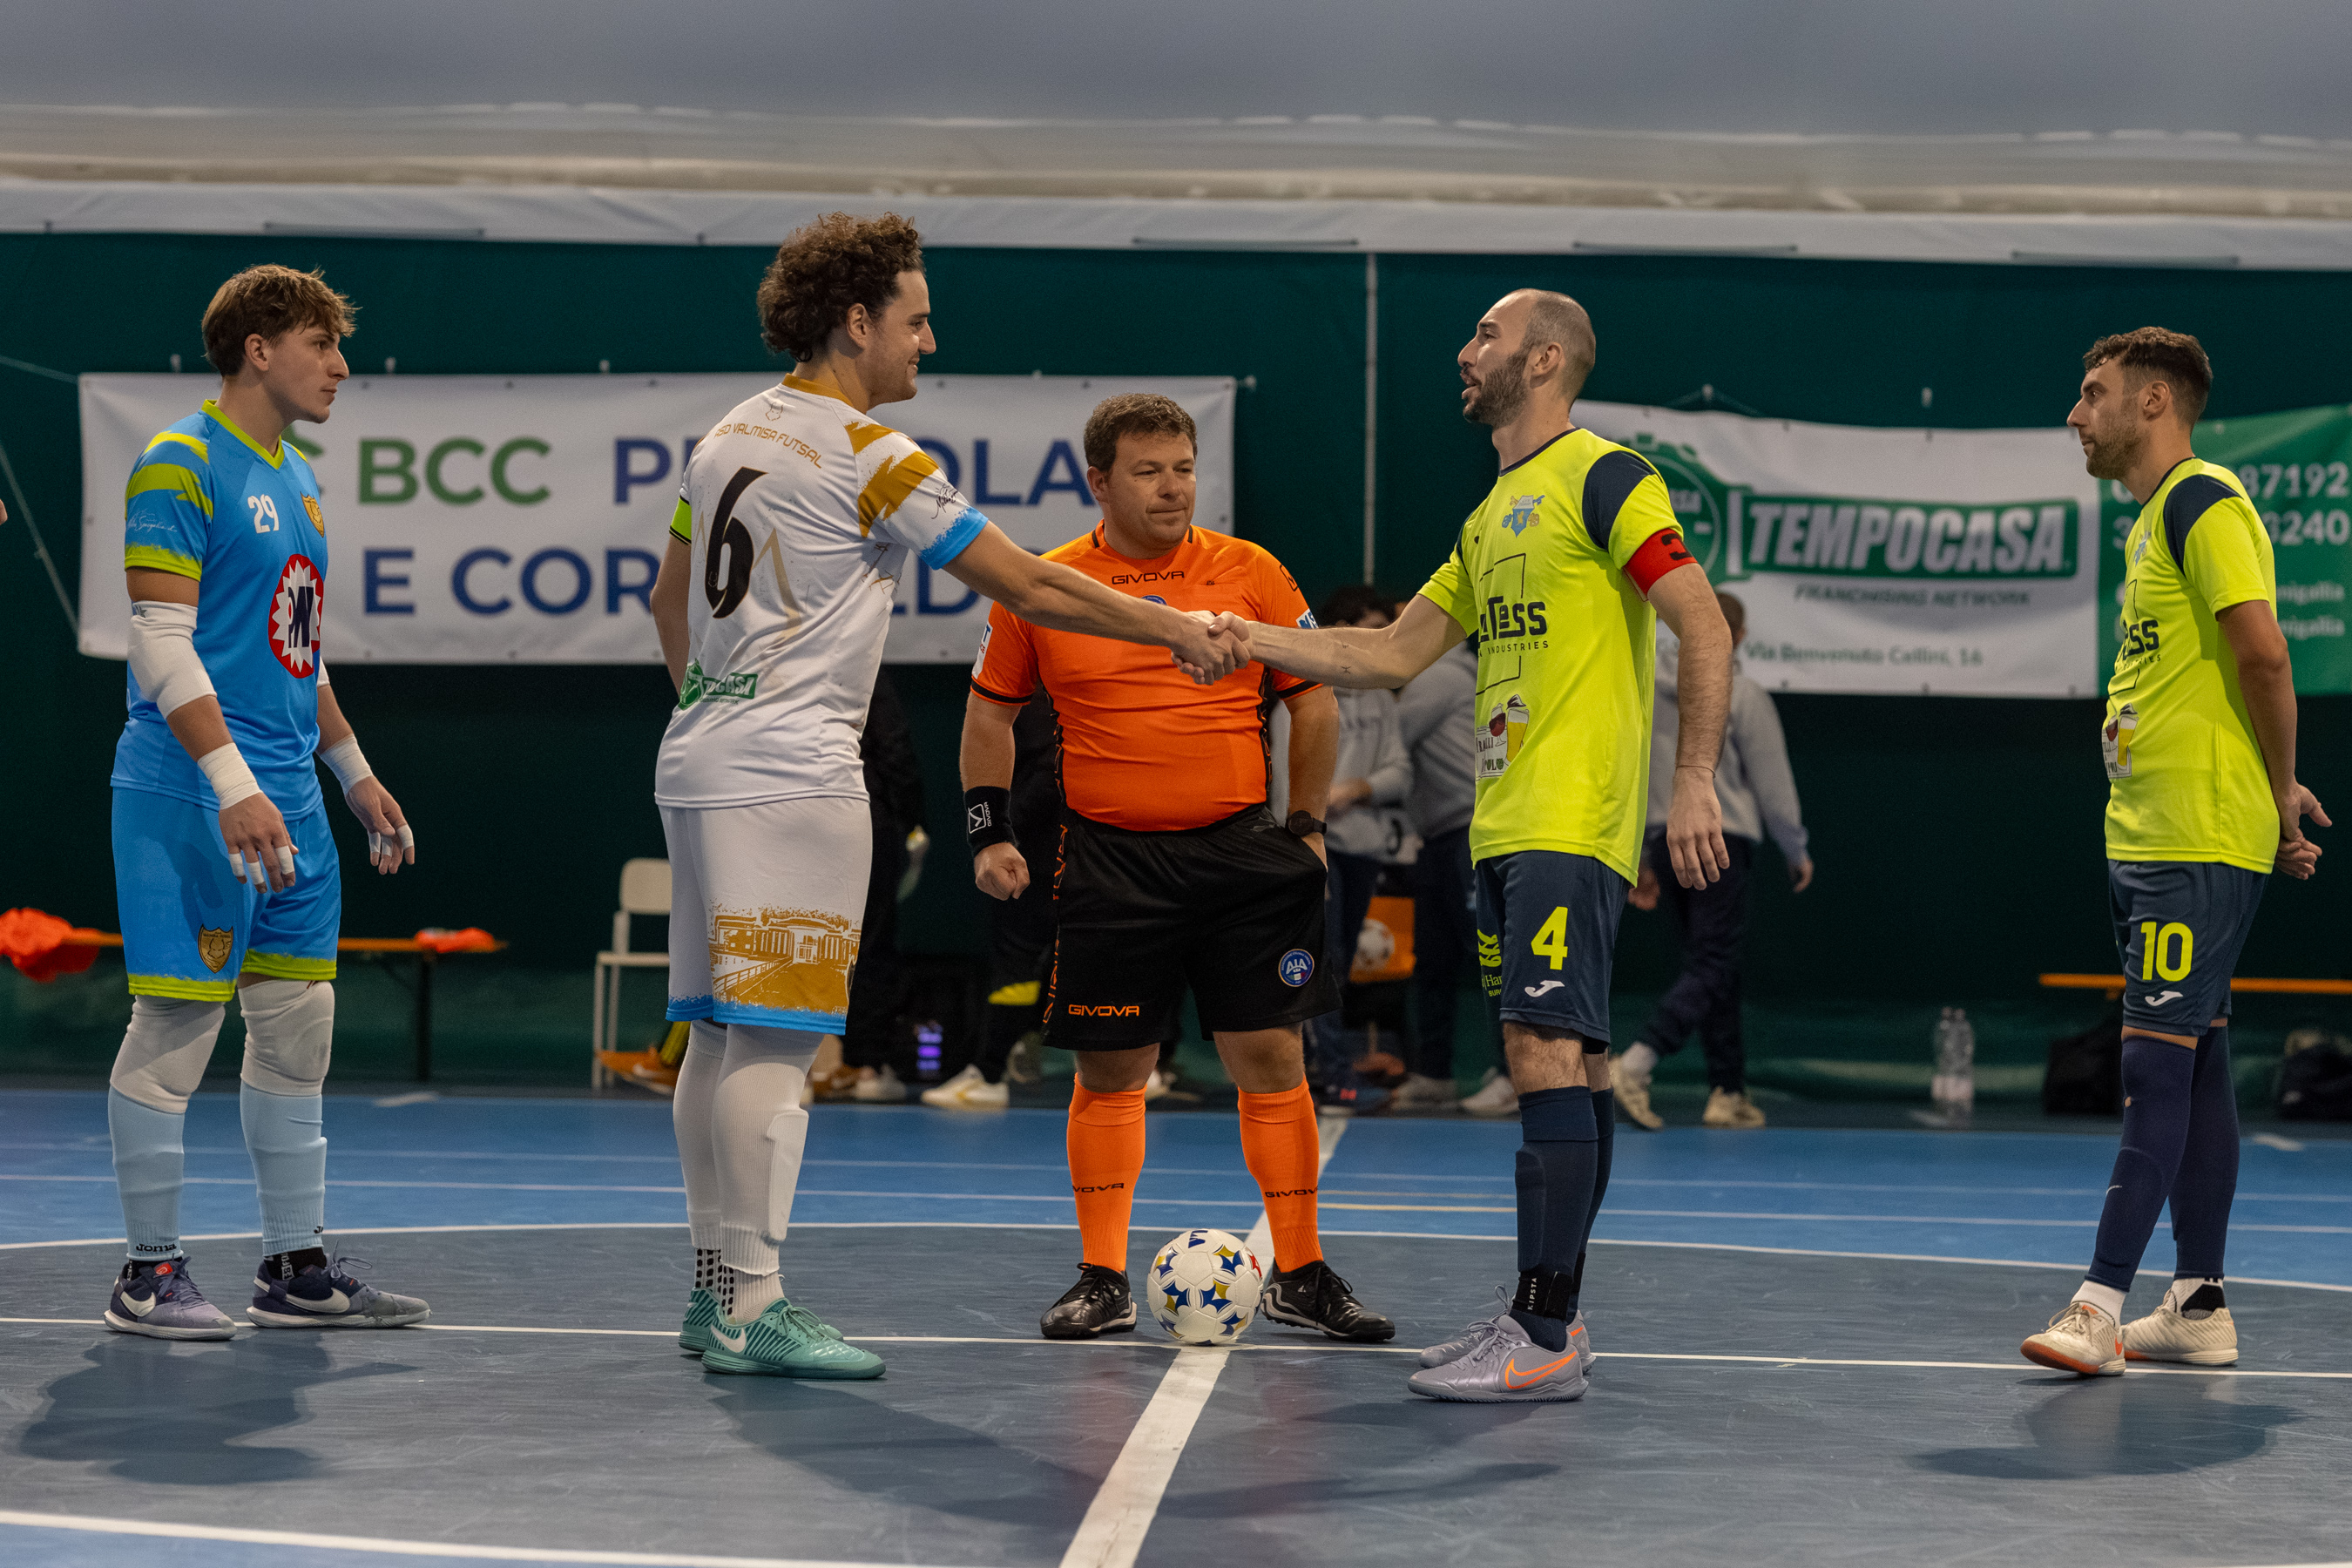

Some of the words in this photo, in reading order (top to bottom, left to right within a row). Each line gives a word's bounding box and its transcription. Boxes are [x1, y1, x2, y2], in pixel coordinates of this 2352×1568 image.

[733, 422, 778, 443] VALMISA
[775, 433, 822, 469] FUTSAL
[358, 436, 552, 507] BCC
[247, 494, 280, 534] 29
[705, 465, 768, 618] 6
[1748, 502, 2066, 574] TEMPOCASA
[362, 549, 416, 614] E
[1112, 571, 1185, 585] GIVOVA
[1487, 640, 1549, 655] INDUSTRIES
[1531, 906, 1569, 970] 4
[2140, 921, 2193, 983] 10
[1068, 1004, 1139, 1017] GIVOVA
[1072, 1182, 1125, 1193] VOVA
[1265, 1185, 1318, 1198] GIVOV
[135, 1243, 177, 1253] Joma
[1527, 1277, 1538, 1311] KIPSTA
